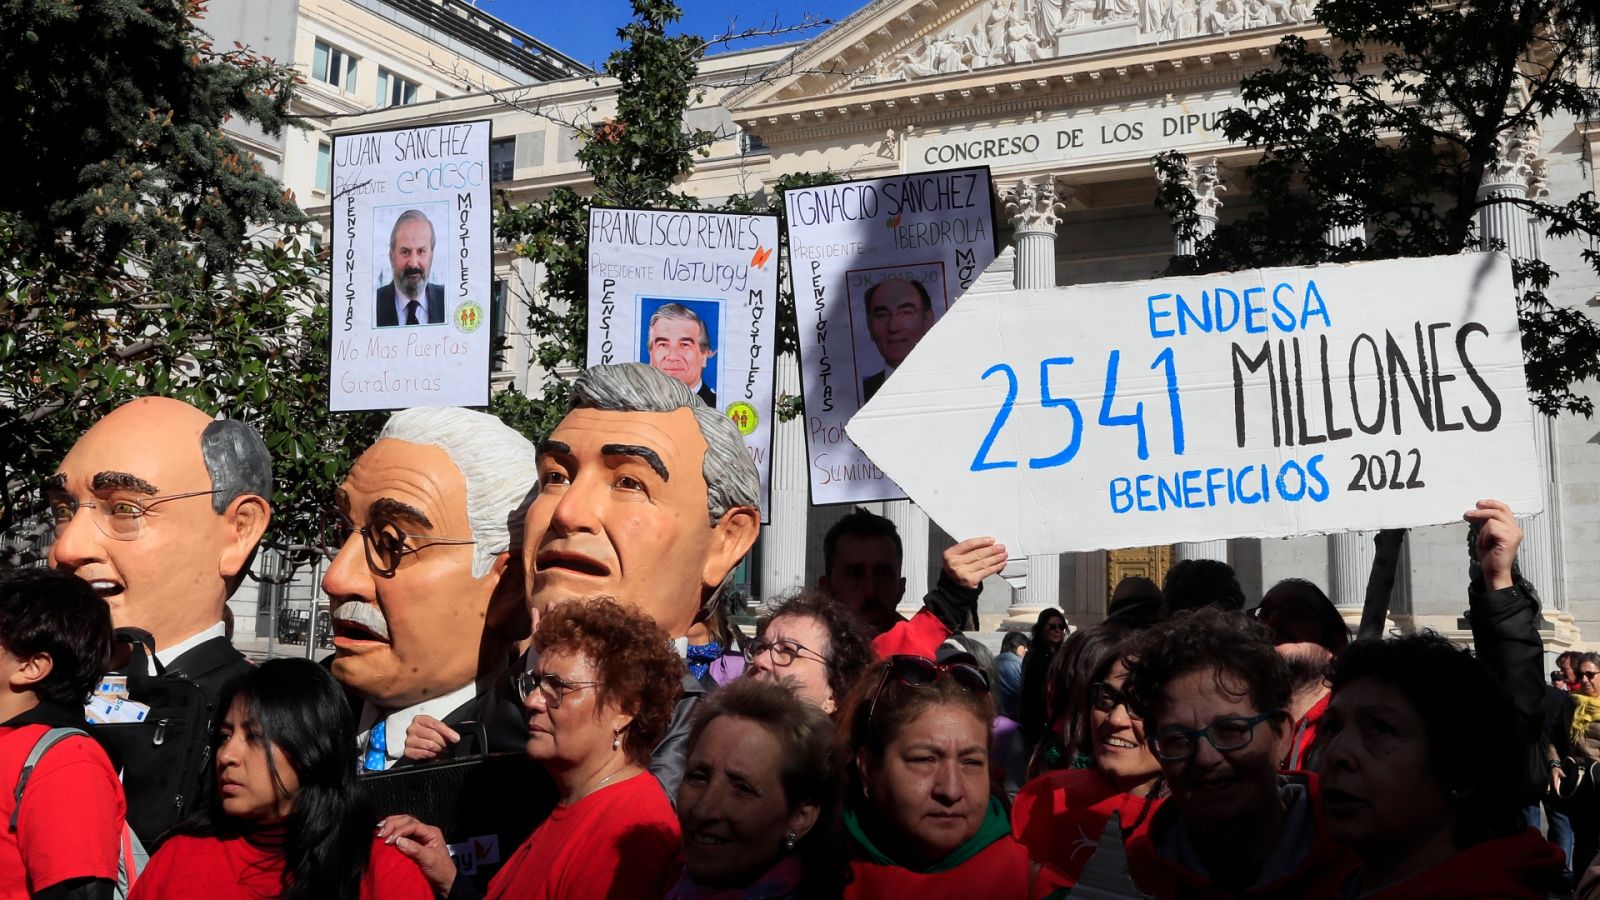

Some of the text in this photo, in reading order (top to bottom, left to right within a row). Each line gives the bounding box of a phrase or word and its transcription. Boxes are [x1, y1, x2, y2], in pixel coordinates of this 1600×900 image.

[336, 124, 473, 167] JUAN SÁNCHEZ
[924, 108, 1226, 166] CONGRESO DE LOS DIPU
[397, 160, 484, 193] endesa
[788, 173, 977, 227] IGNACIO SÁNCHEZ
[591, 211, 691, 246] FRANCISCO
[793, 216, 986, 260] PRESIDENTE IBERDROLA
[344, 196, 356, 331] PENSIONISTAS
[591, 252, 656, 280] PRESIDENTE
[599, 279, 616, 365] PENSION
[811, 261, 834, 412] PENSIONISTAS
[1147, 280, 1332, 339] ENDESA
[337, 339, 359, 361] No
[366, 336, 398, 360] Mas
[969, 321, 1503, 472] 2541 MILLONES
[1110, 448, 1427, 516] BENEFICIOS 2022
